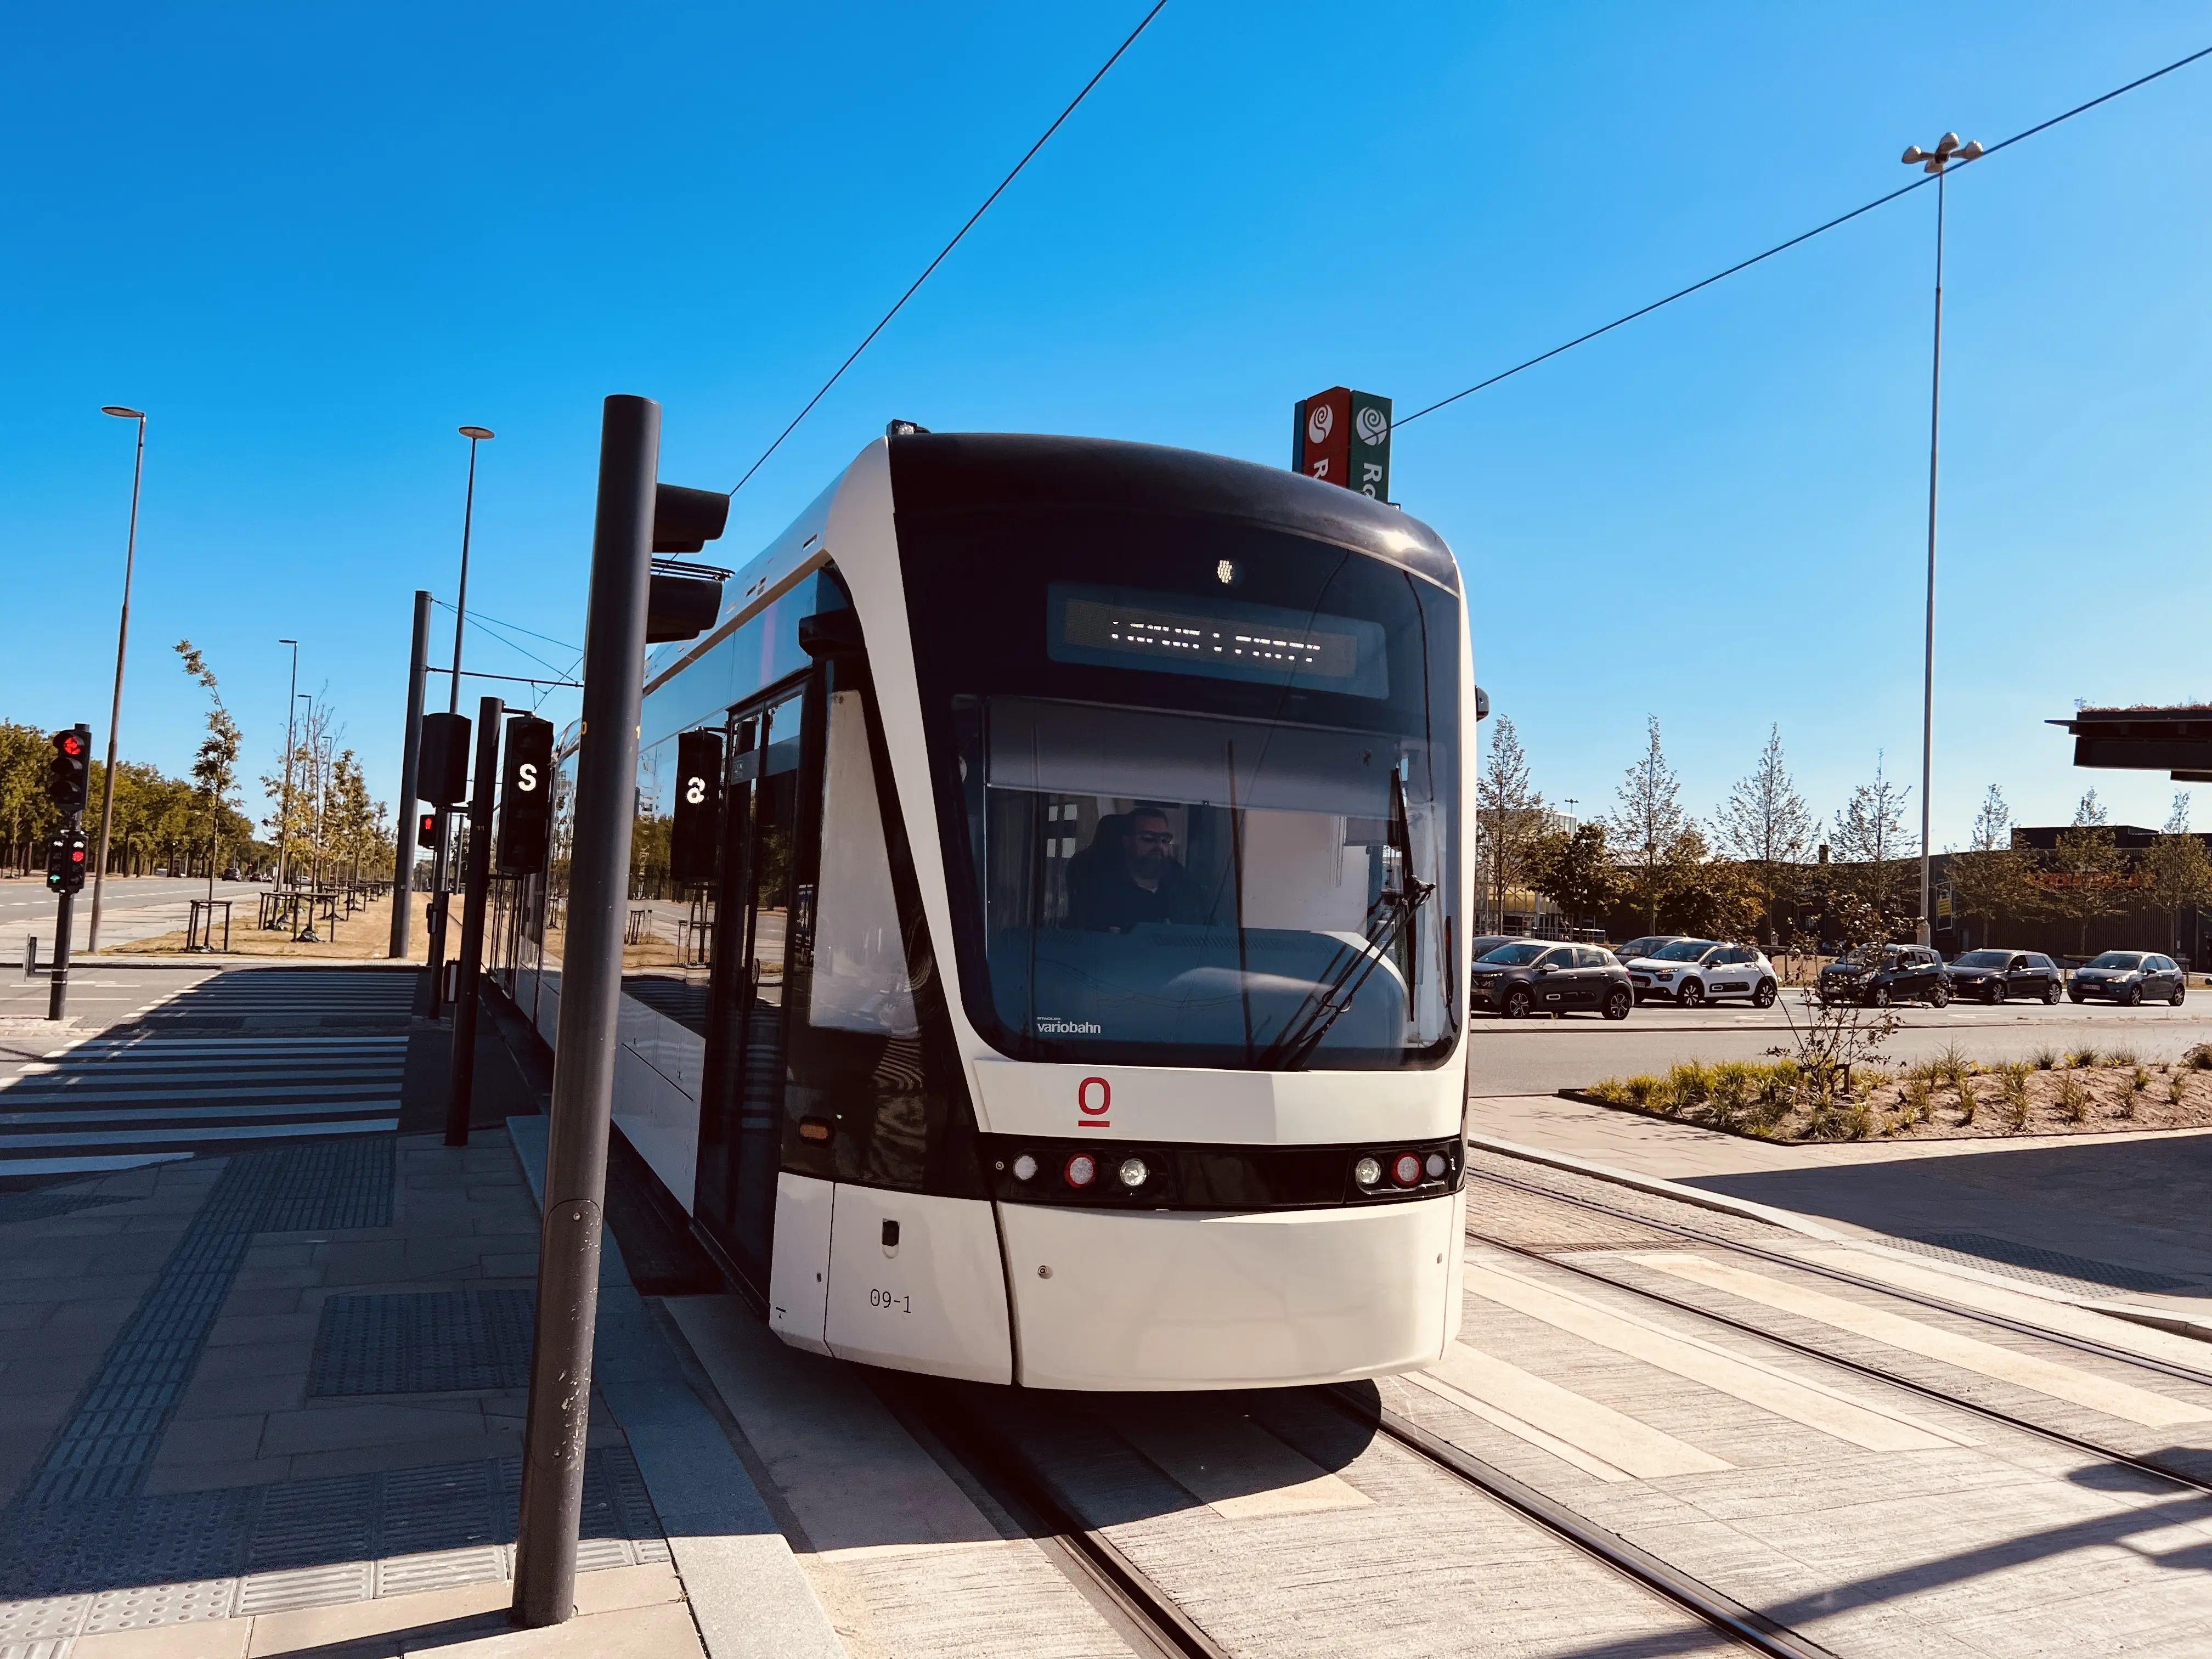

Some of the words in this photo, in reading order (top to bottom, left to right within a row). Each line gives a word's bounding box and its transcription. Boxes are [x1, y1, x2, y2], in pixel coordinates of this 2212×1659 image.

[518, 764, 537, 791] S
[1037, 1021, 1101, 1034] variobahn
[870, 1289, 912, 1314] 09-1
